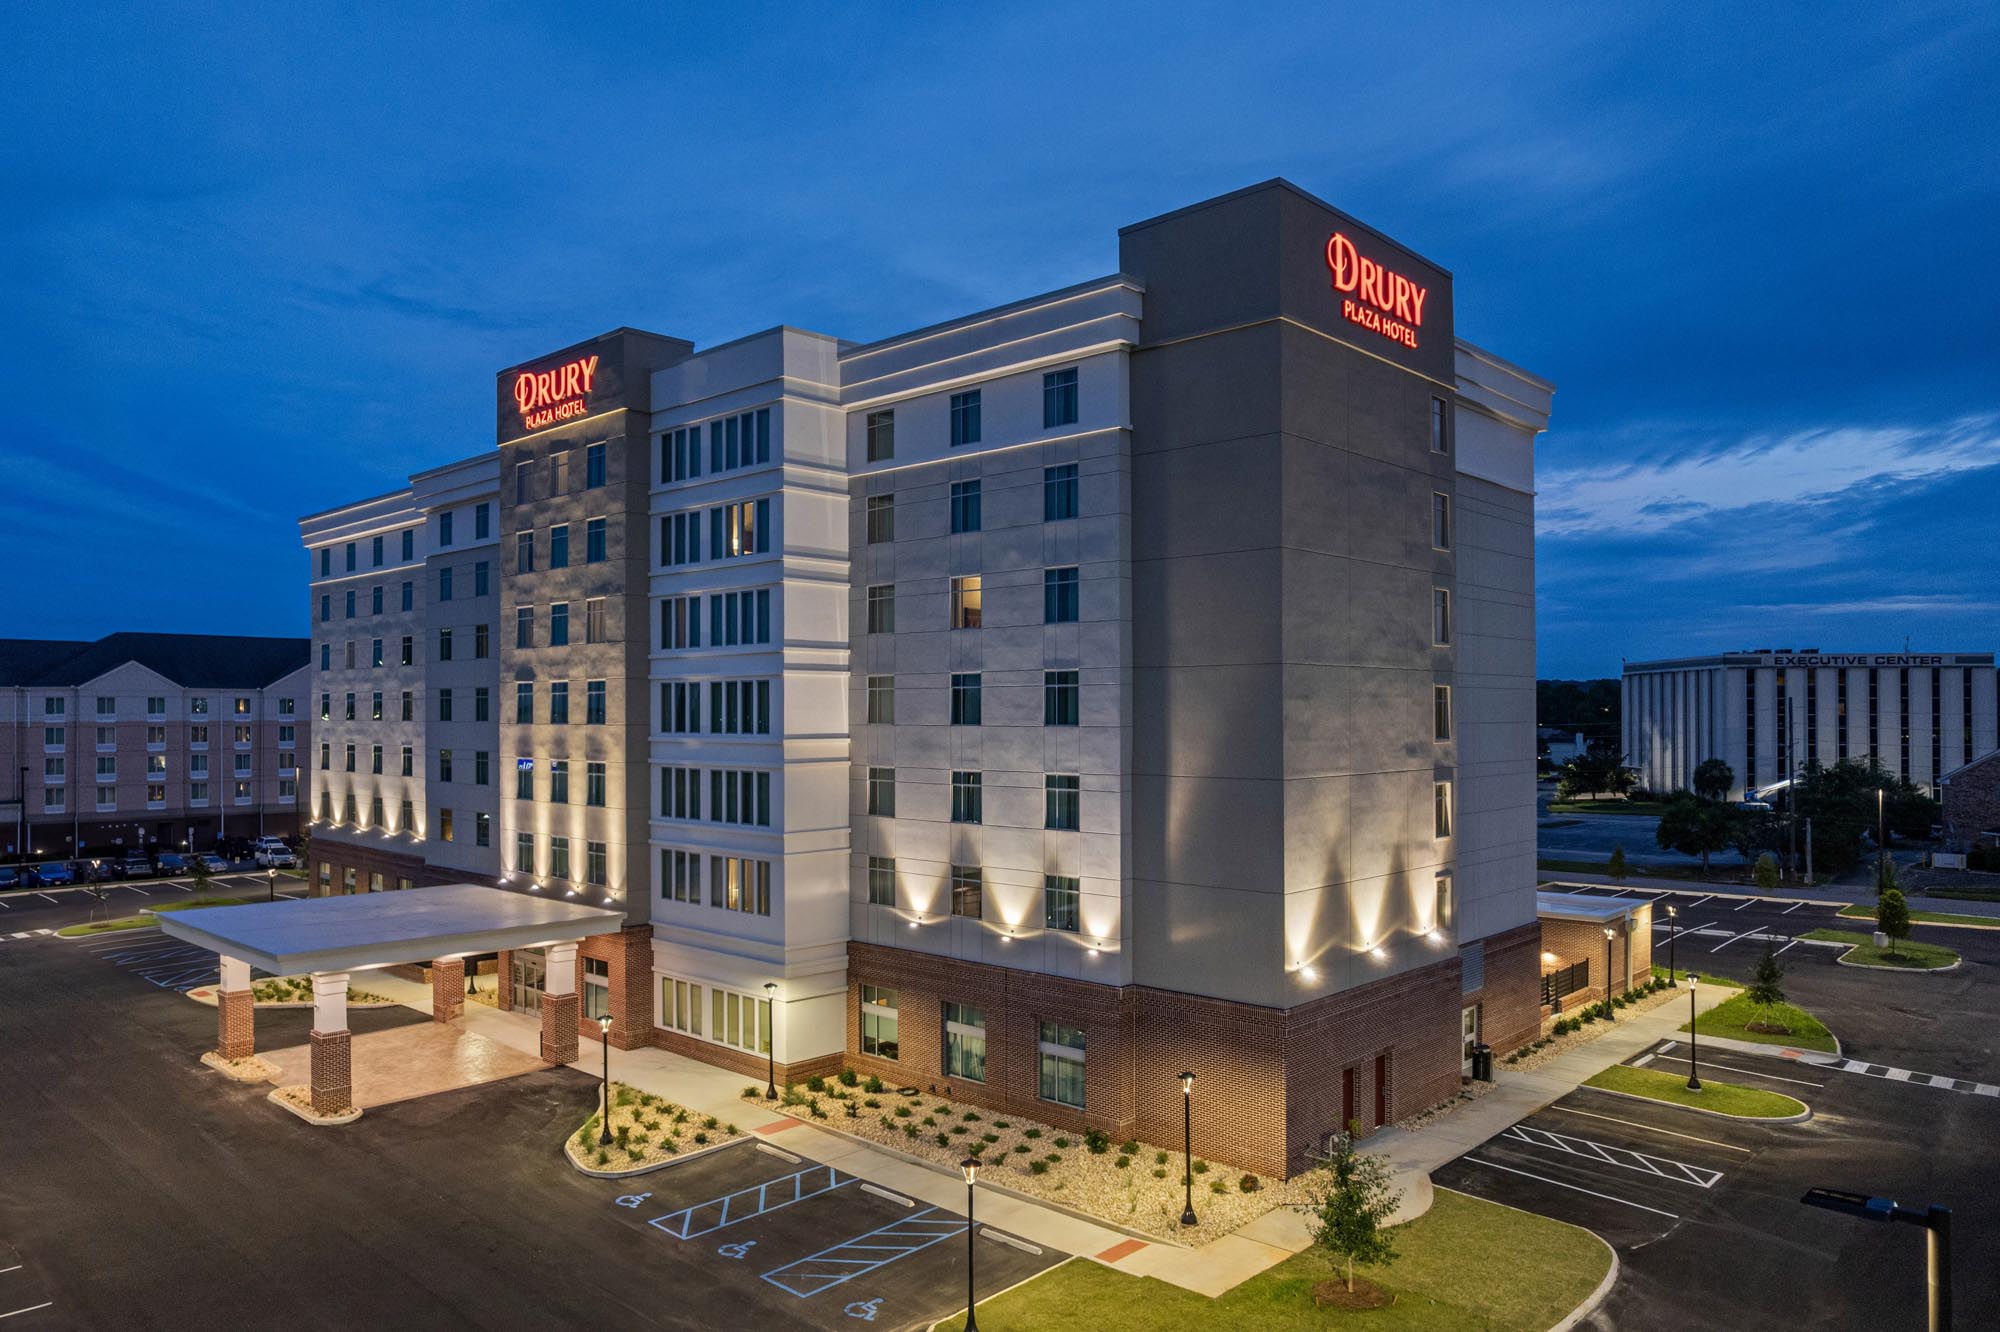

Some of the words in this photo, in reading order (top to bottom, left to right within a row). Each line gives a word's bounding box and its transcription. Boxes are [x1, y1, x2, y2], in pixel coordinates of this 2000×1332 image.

[1327, 232, 1426, 326] DRURY
[1344, 300, 1381, 333] PLAZA
[1382, 317, 1418, 349] HOTEL
[514, 355, 599, 414] DRURY
[525, 409, 555, 430] PLAZA
[555, 399, 588, 420] HOTEL
[1774, 655, 1868, 666] EXECUTIVE
[1874, 655, 1943, 665] CENTER
